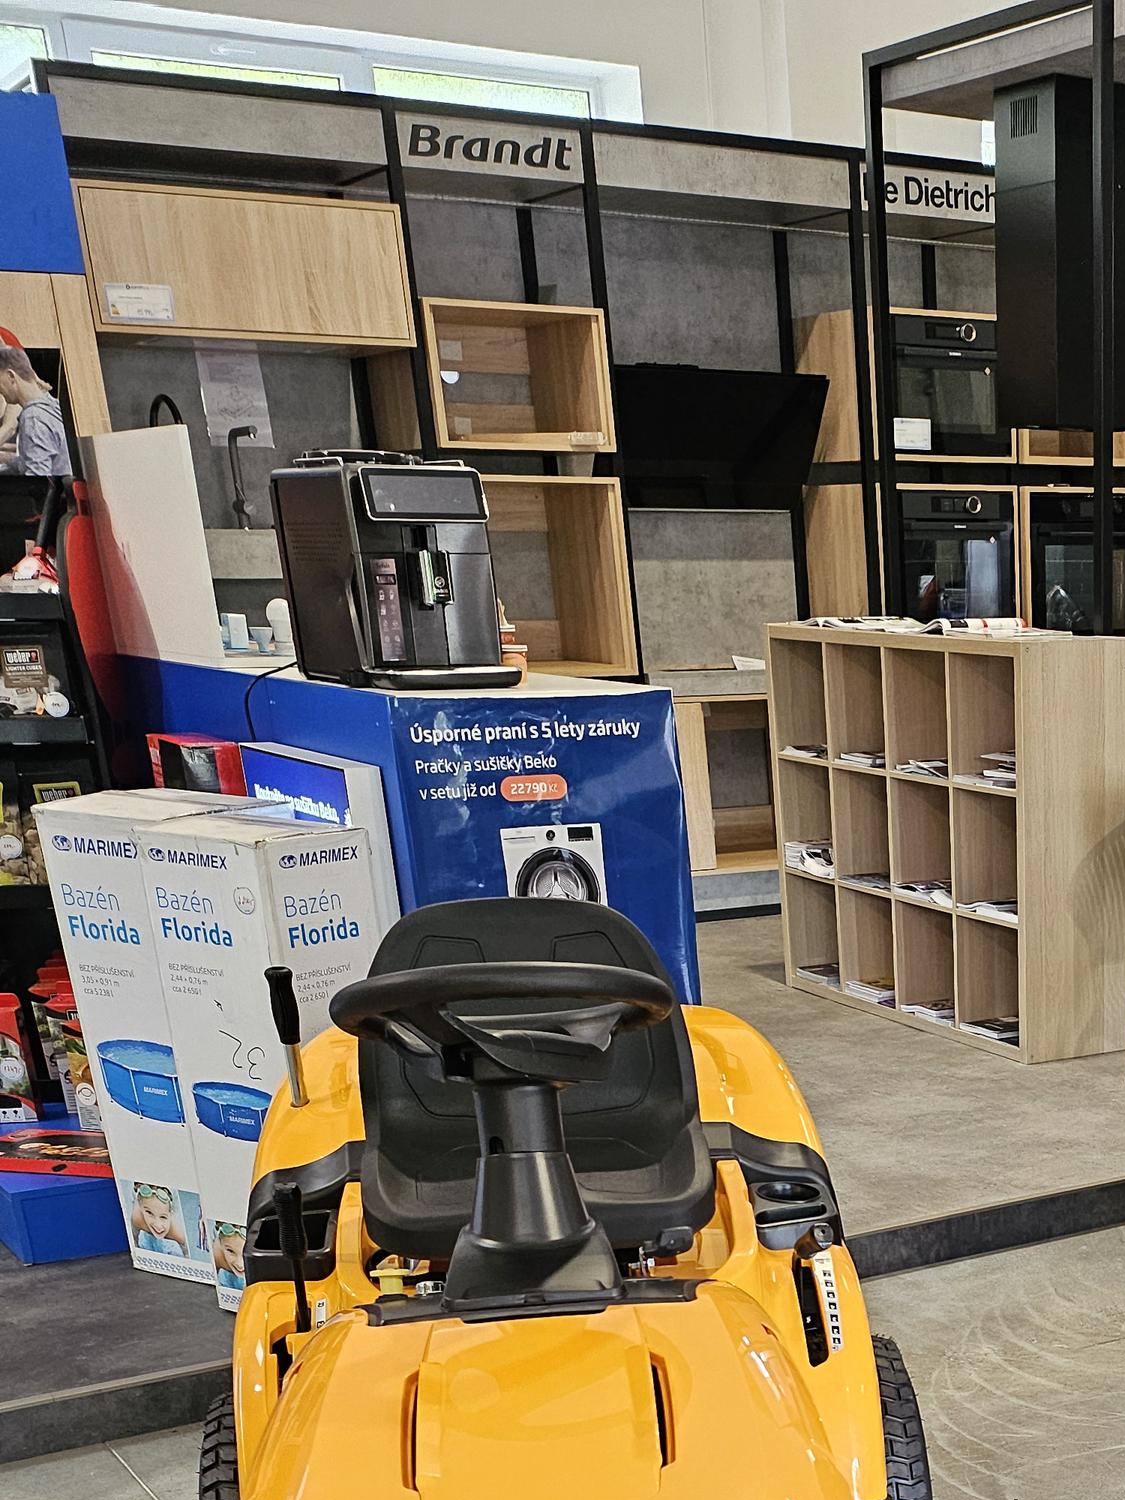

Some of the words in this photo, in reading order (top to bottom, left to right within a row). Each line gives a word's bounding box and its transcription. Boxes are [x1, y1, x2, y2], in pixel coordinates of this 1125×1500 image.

[409, 124, 572, 171] Brandt
[904, 176, 996, 213] Dietrich
[6, 650, 31, 664] weber
[410, 724, 482, 746] Úsporné
[485, 722, 527, 744] praní
[529, 724, 540, 740] s
[541, 722, 552, 739] 5
[554, 720, 585, 742] lety
[588, 719, 641, 740] záruky
[415, 758, 461, 775] Pračky
[464, 761, 472, 773] a
[474, 755, 522, 773] sušičky
[525, 755, 558, 770] Beko
[419, 788, 429, 801] v
[430, 784, 461, 799] setu
[462, 783, 478, 801] již
[480, 782, 497, 797] od
[167, 849, 229, 871] MARIMEX
[299, 845, 359, 868] MARIMEX
[61, 883, 121, 912] Bazén
[155, 887, 214, 915] Bazén
[284, 888, 342, 918] Bazén
[67, 915, 141, 946] Florida
[161, 917, 233, 948] Florida
[288, 916, 360, 949] Florida
[79, 964, 91, 973] BEZ
[168, 962, 180, 972] BEZ
[295, 973, 308, 982] BEZ
